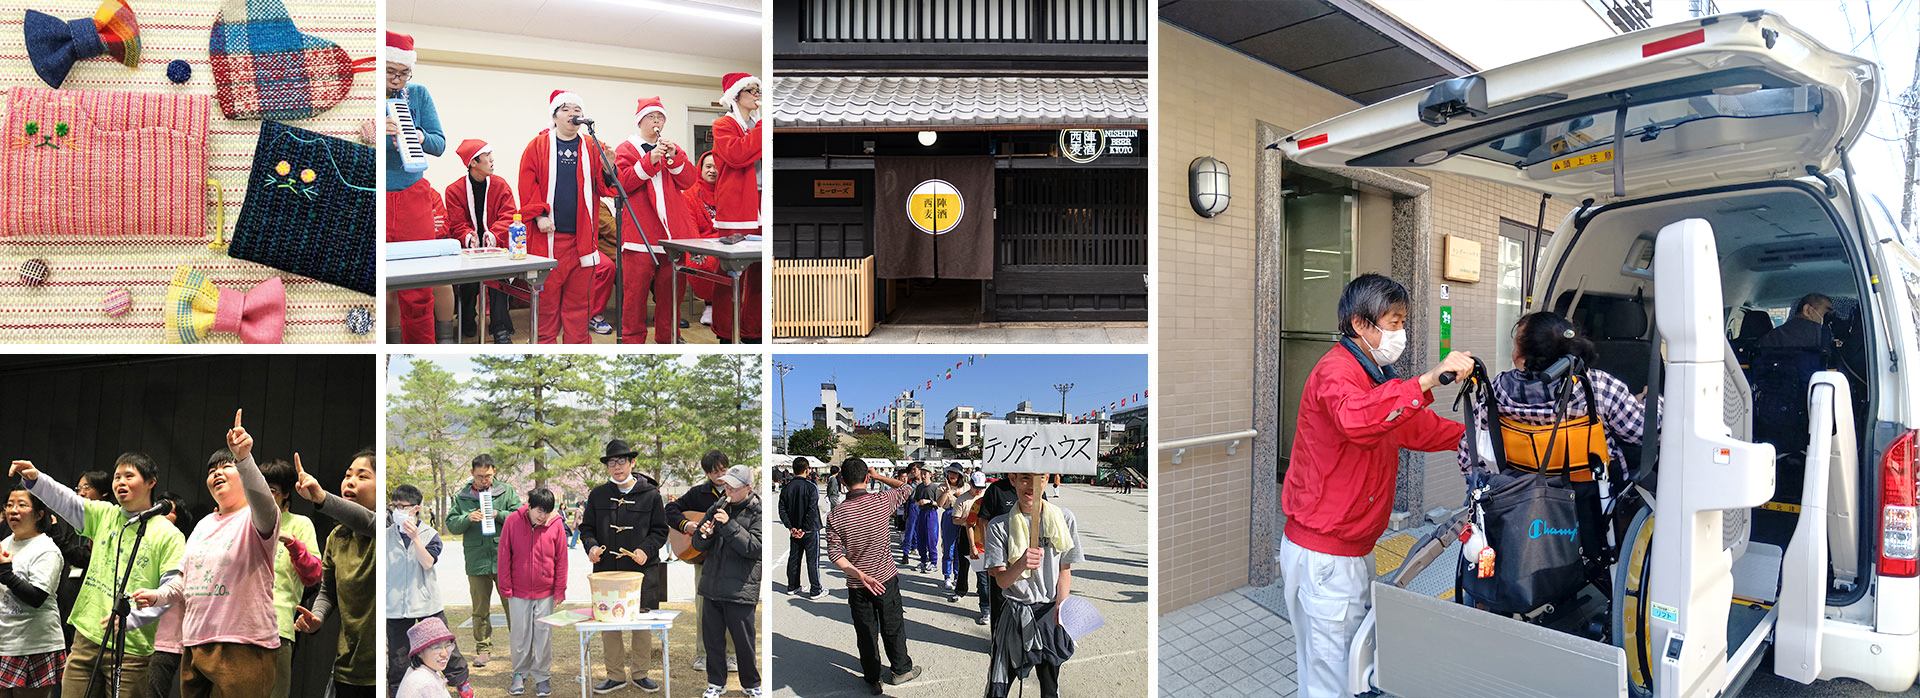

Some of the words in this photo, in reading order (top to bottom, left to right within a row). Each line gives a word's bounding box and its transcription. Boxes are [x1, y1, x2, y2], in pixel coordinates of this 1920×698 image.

[1070, 131, 1096, 143] 西陣
[1105, 130, 1137, 138] NISHIJIN
[1111, 138, 1131, 146] BEER
[1070, 143, 1096, 156] 麦酒
[985, 432, 1091, 464] テンダーハウス
